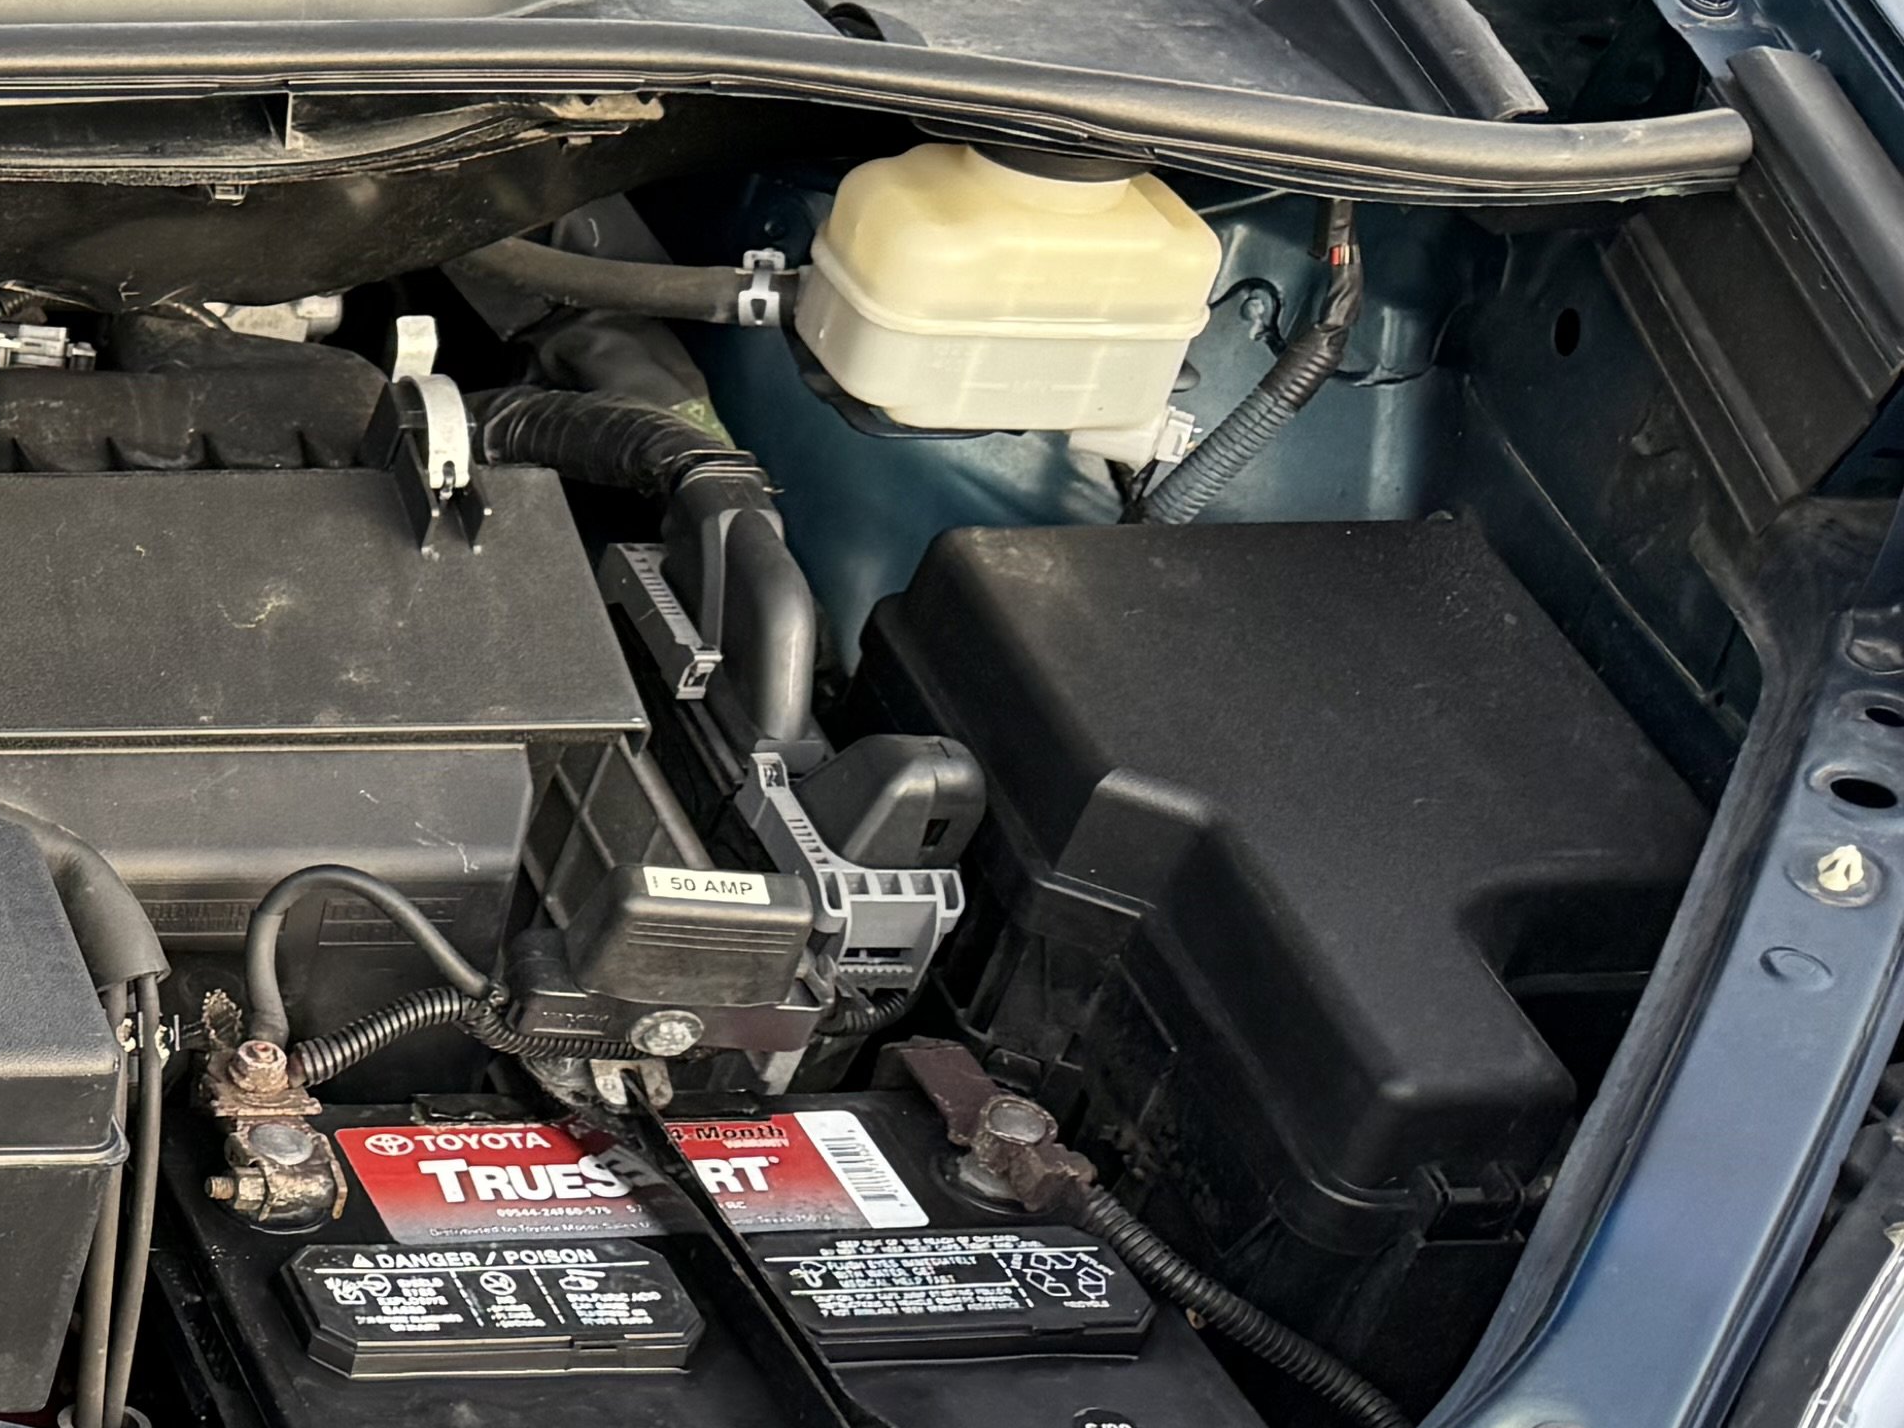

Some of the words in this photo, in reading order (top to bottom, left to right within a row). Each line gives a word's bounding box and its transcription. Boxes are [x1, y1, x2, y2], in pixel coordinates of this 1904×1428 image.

[670, 876, 697, 893] 50
[703, 879, 754, 896] AMP
[414, 1132, 553, 1152] TOYOTA
[376, 1250, 482, 1270] DANGER
[503, 1248, 598, 1266] POISON
